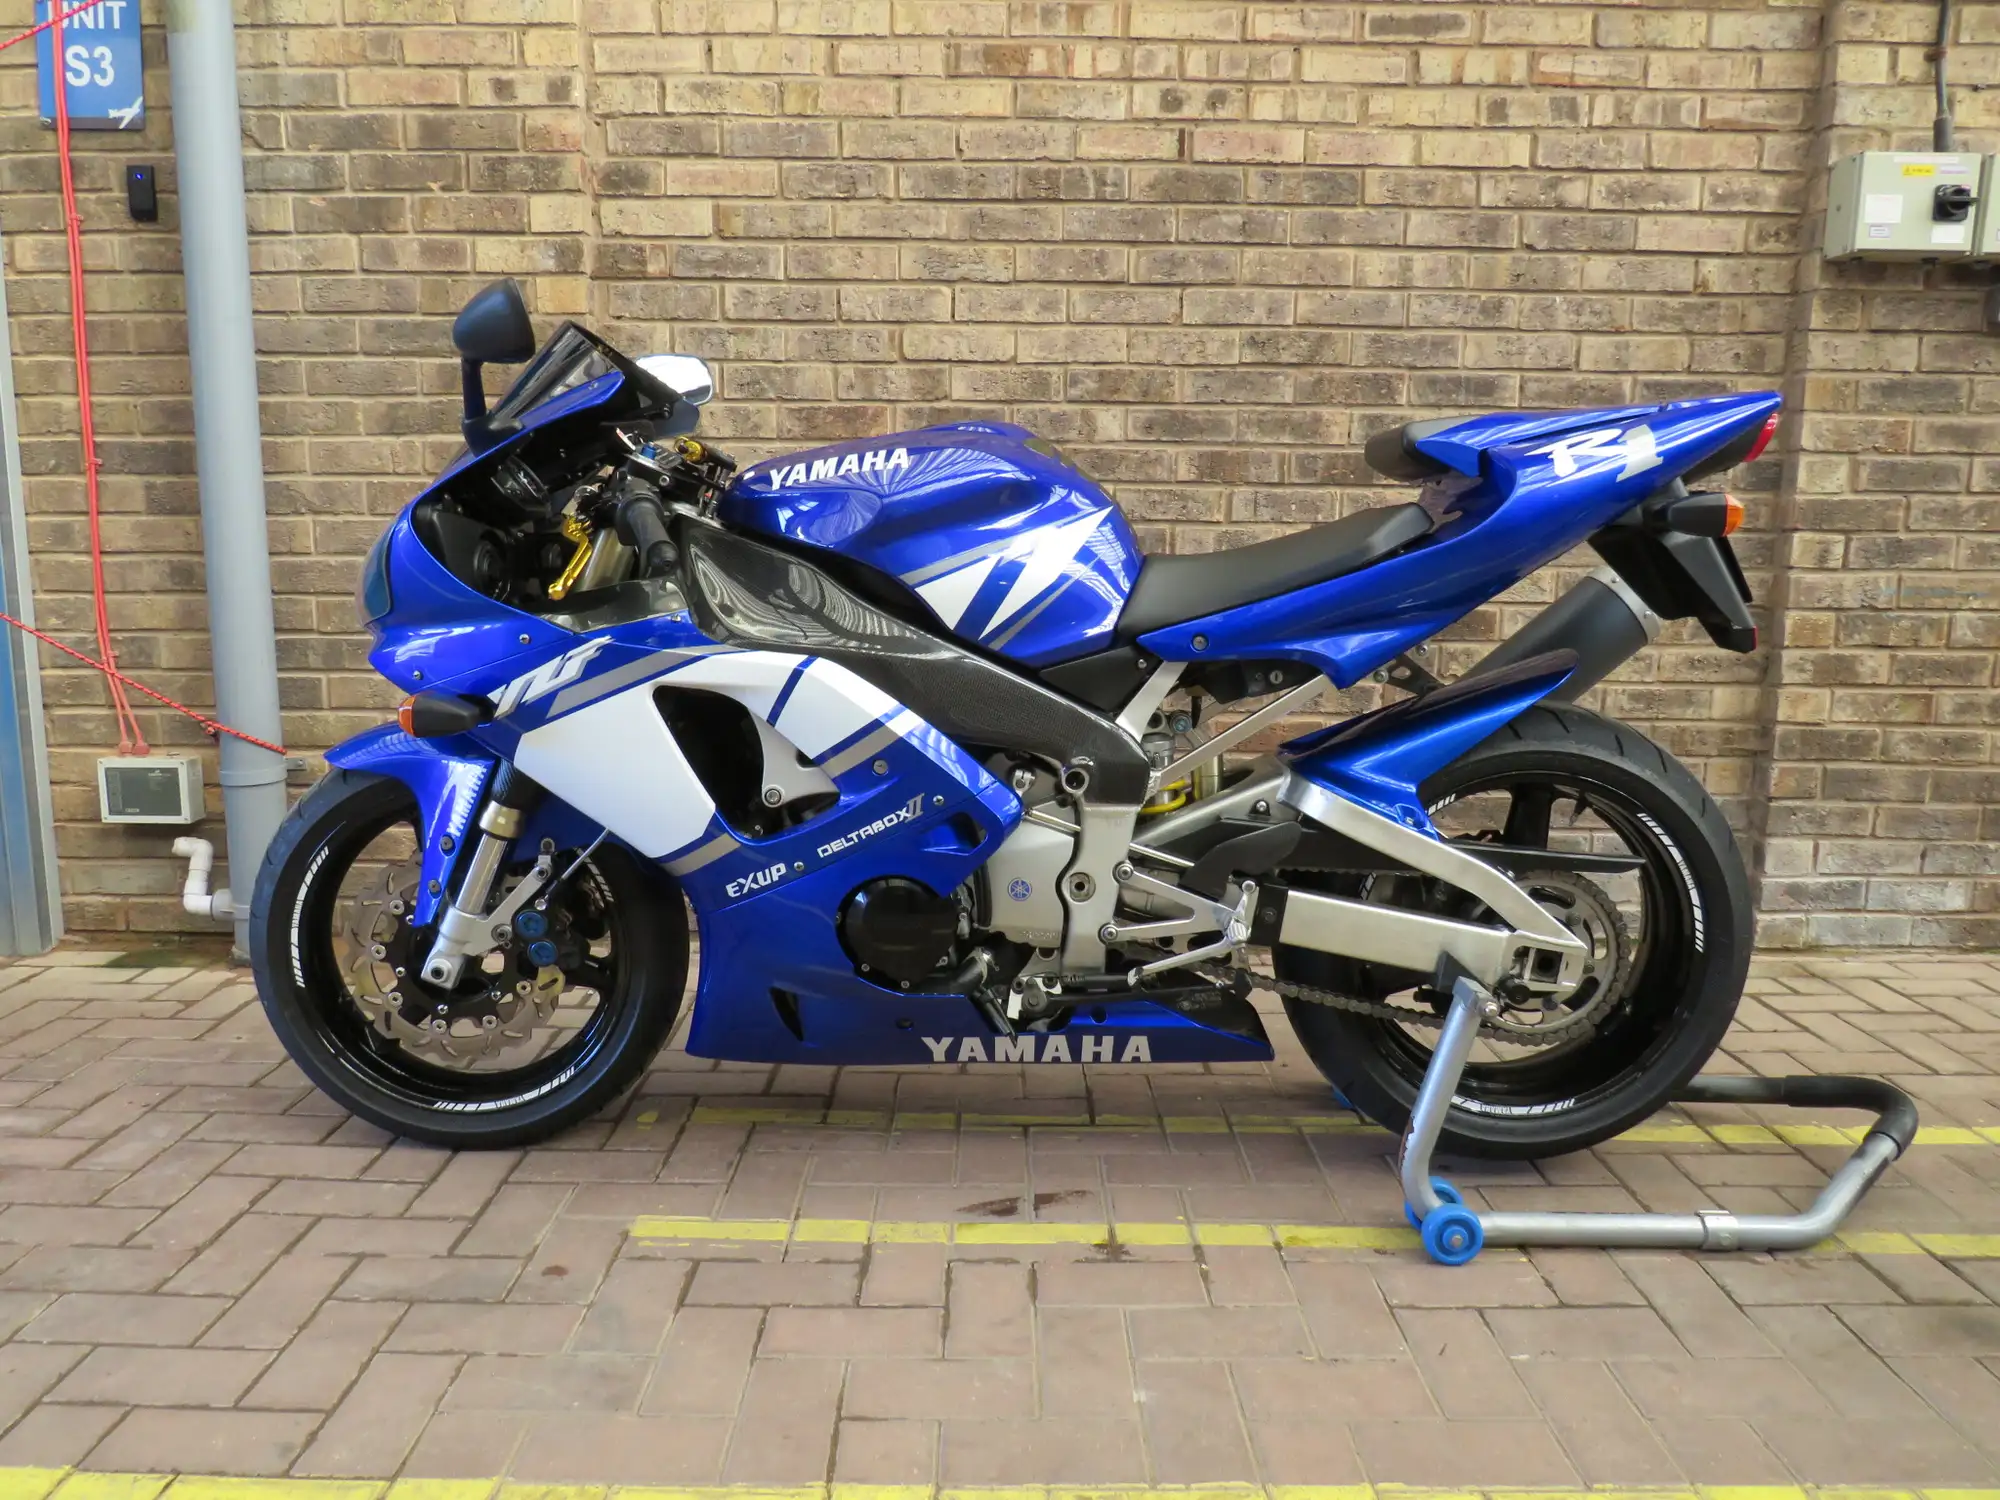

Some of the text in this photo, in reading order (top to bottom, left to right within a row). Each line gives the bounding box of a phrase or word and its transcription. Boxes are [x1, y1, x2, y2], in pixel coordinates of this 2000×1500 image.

[65, 45, 115, 87] S3
[769, 447, 909, 491] YAMAHA
[1524, 424, 1664, 482] R1
[726, 863, 787, 898] EXUP
[921, 1035, 1152, 1062] YAMAHA
